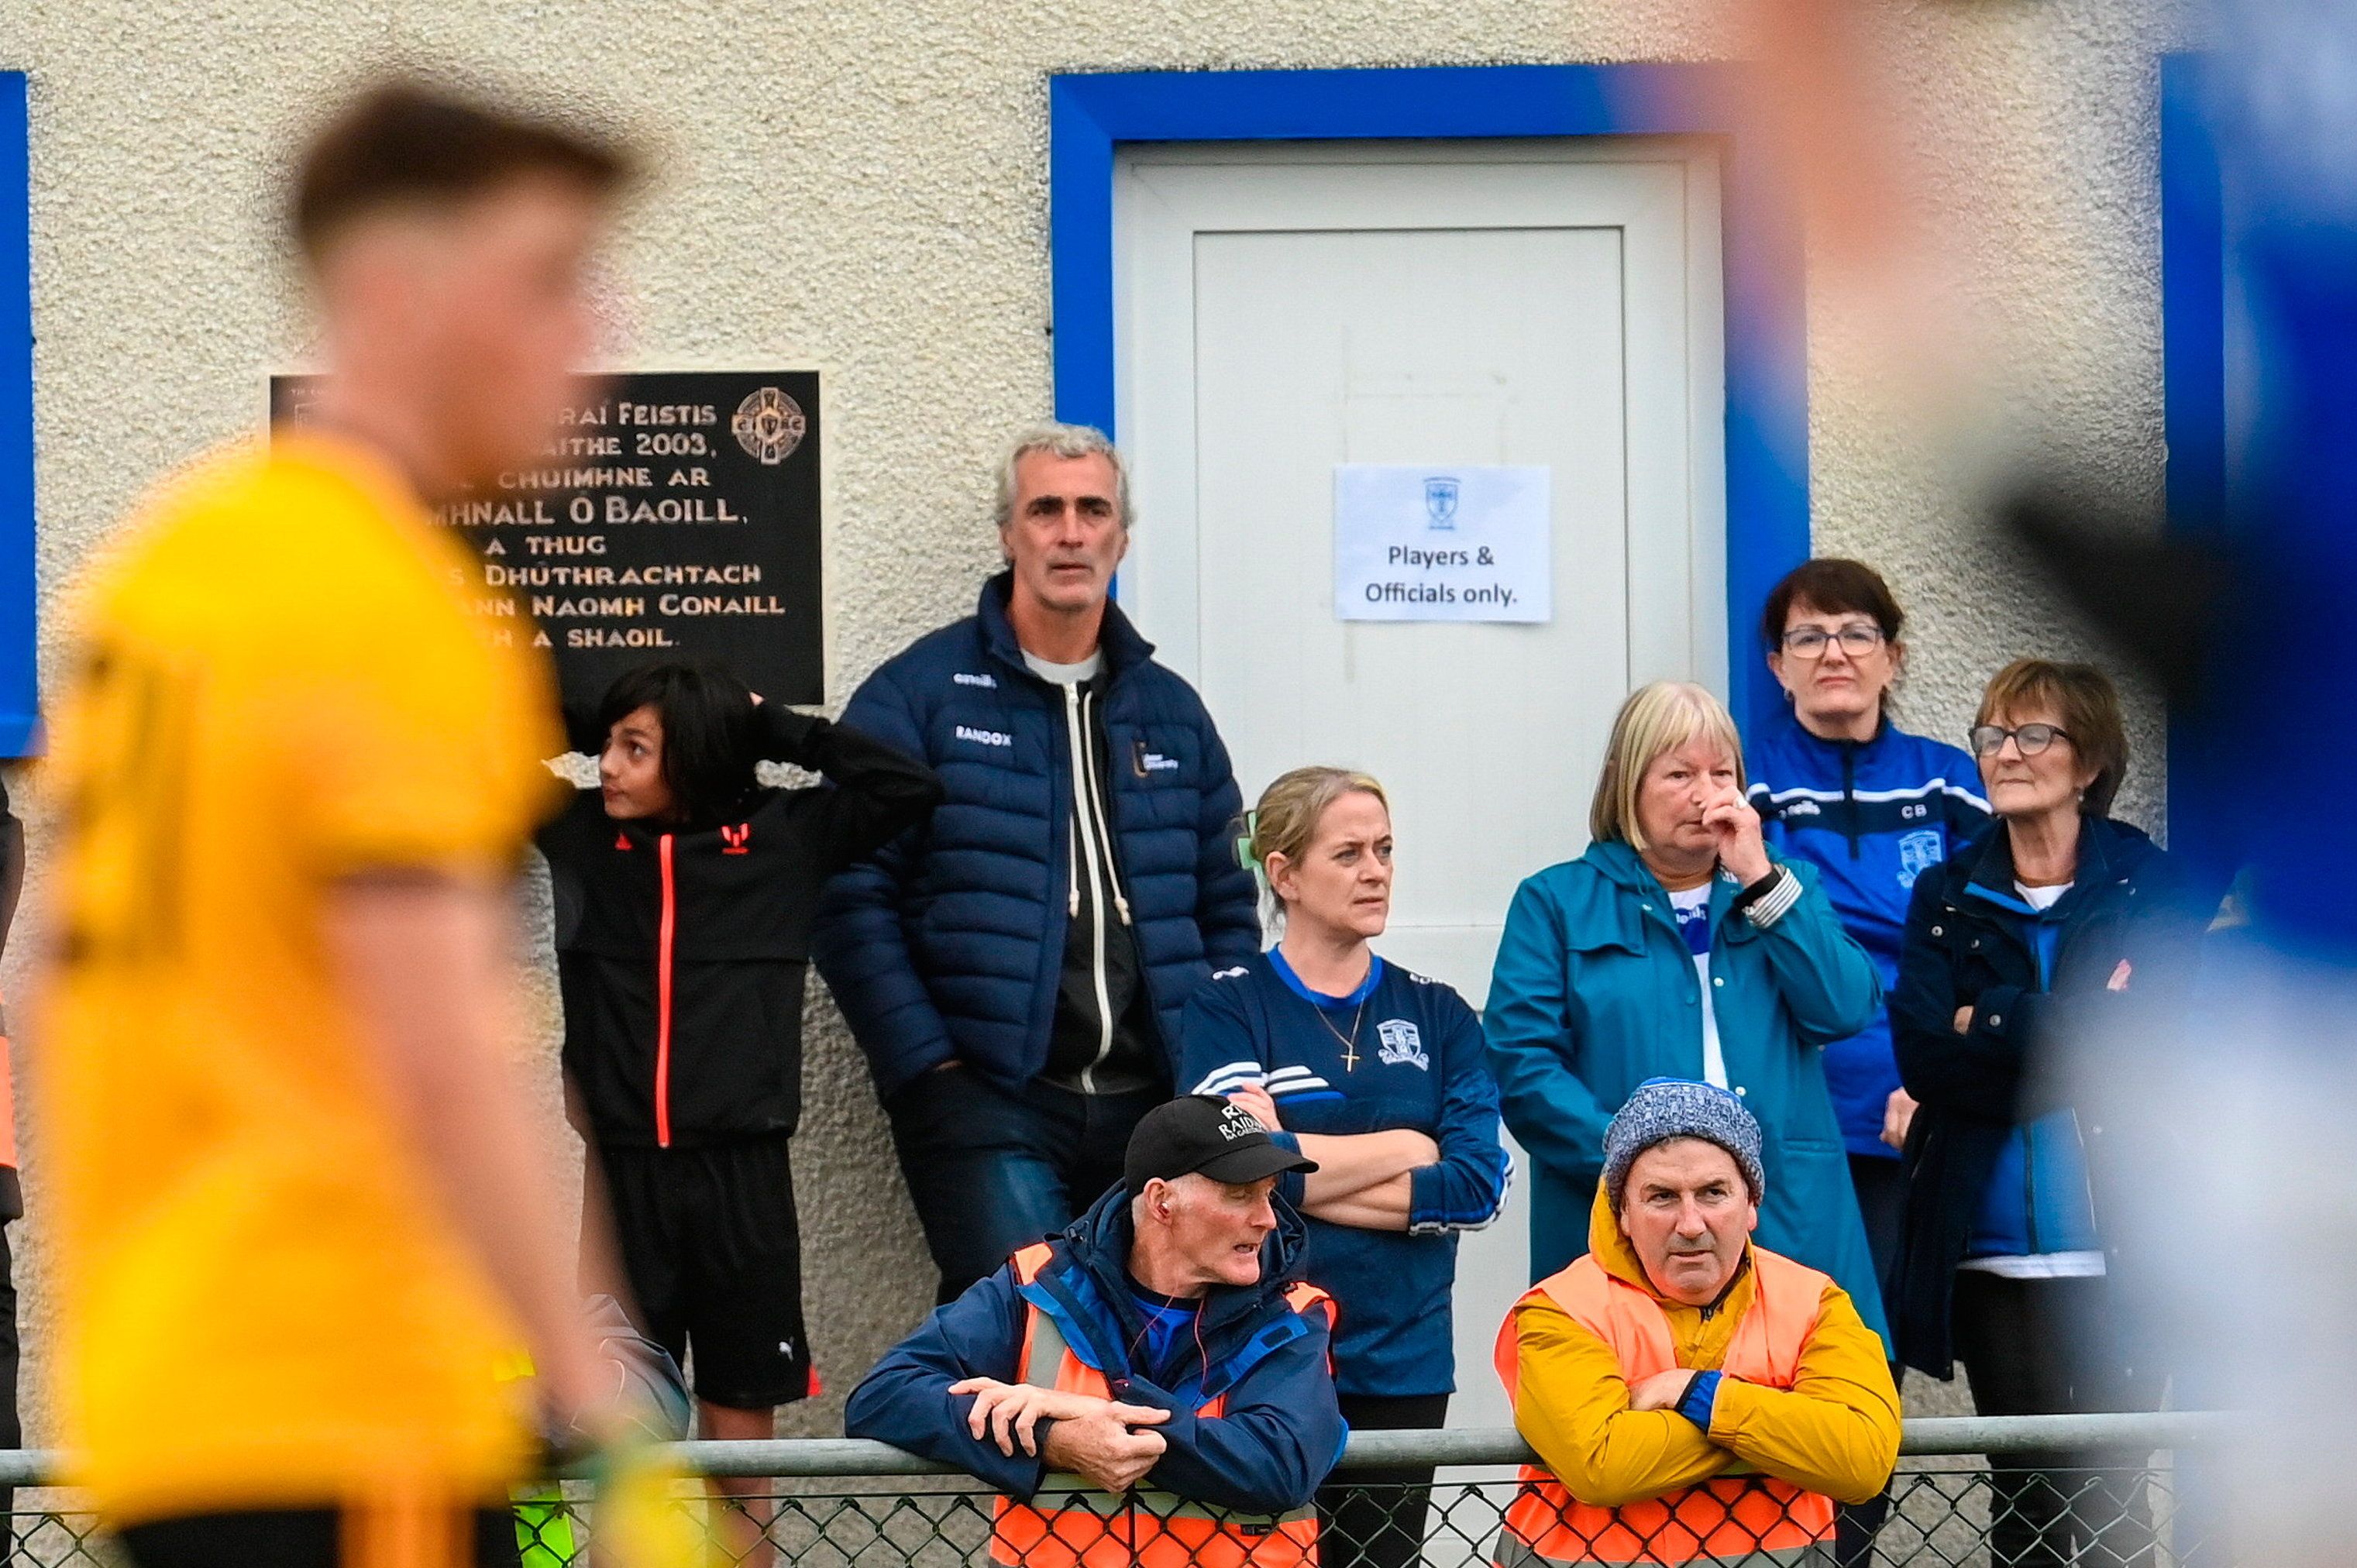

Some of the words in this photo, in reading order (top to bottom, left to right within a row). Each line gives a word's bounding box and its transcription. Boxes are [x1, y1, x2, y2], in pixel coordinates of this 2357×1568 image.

[559, 400, 607, 425] RAÍ
[635, 433, 717, 458] 2003,
[667, 467, 711, 487] AR
[484, 538, 507, 555] A
[525, 535, 607, 555] THUG
[1388, 545, 1468, 569] Players
[1477, 546, 1494, 566] &
[532, 595, 645, 617] NAOMH
[1365, 583, 1455, 602] Officials
[1464, 583, 1518, 607] only.
[533, 630, 554, 647] A
